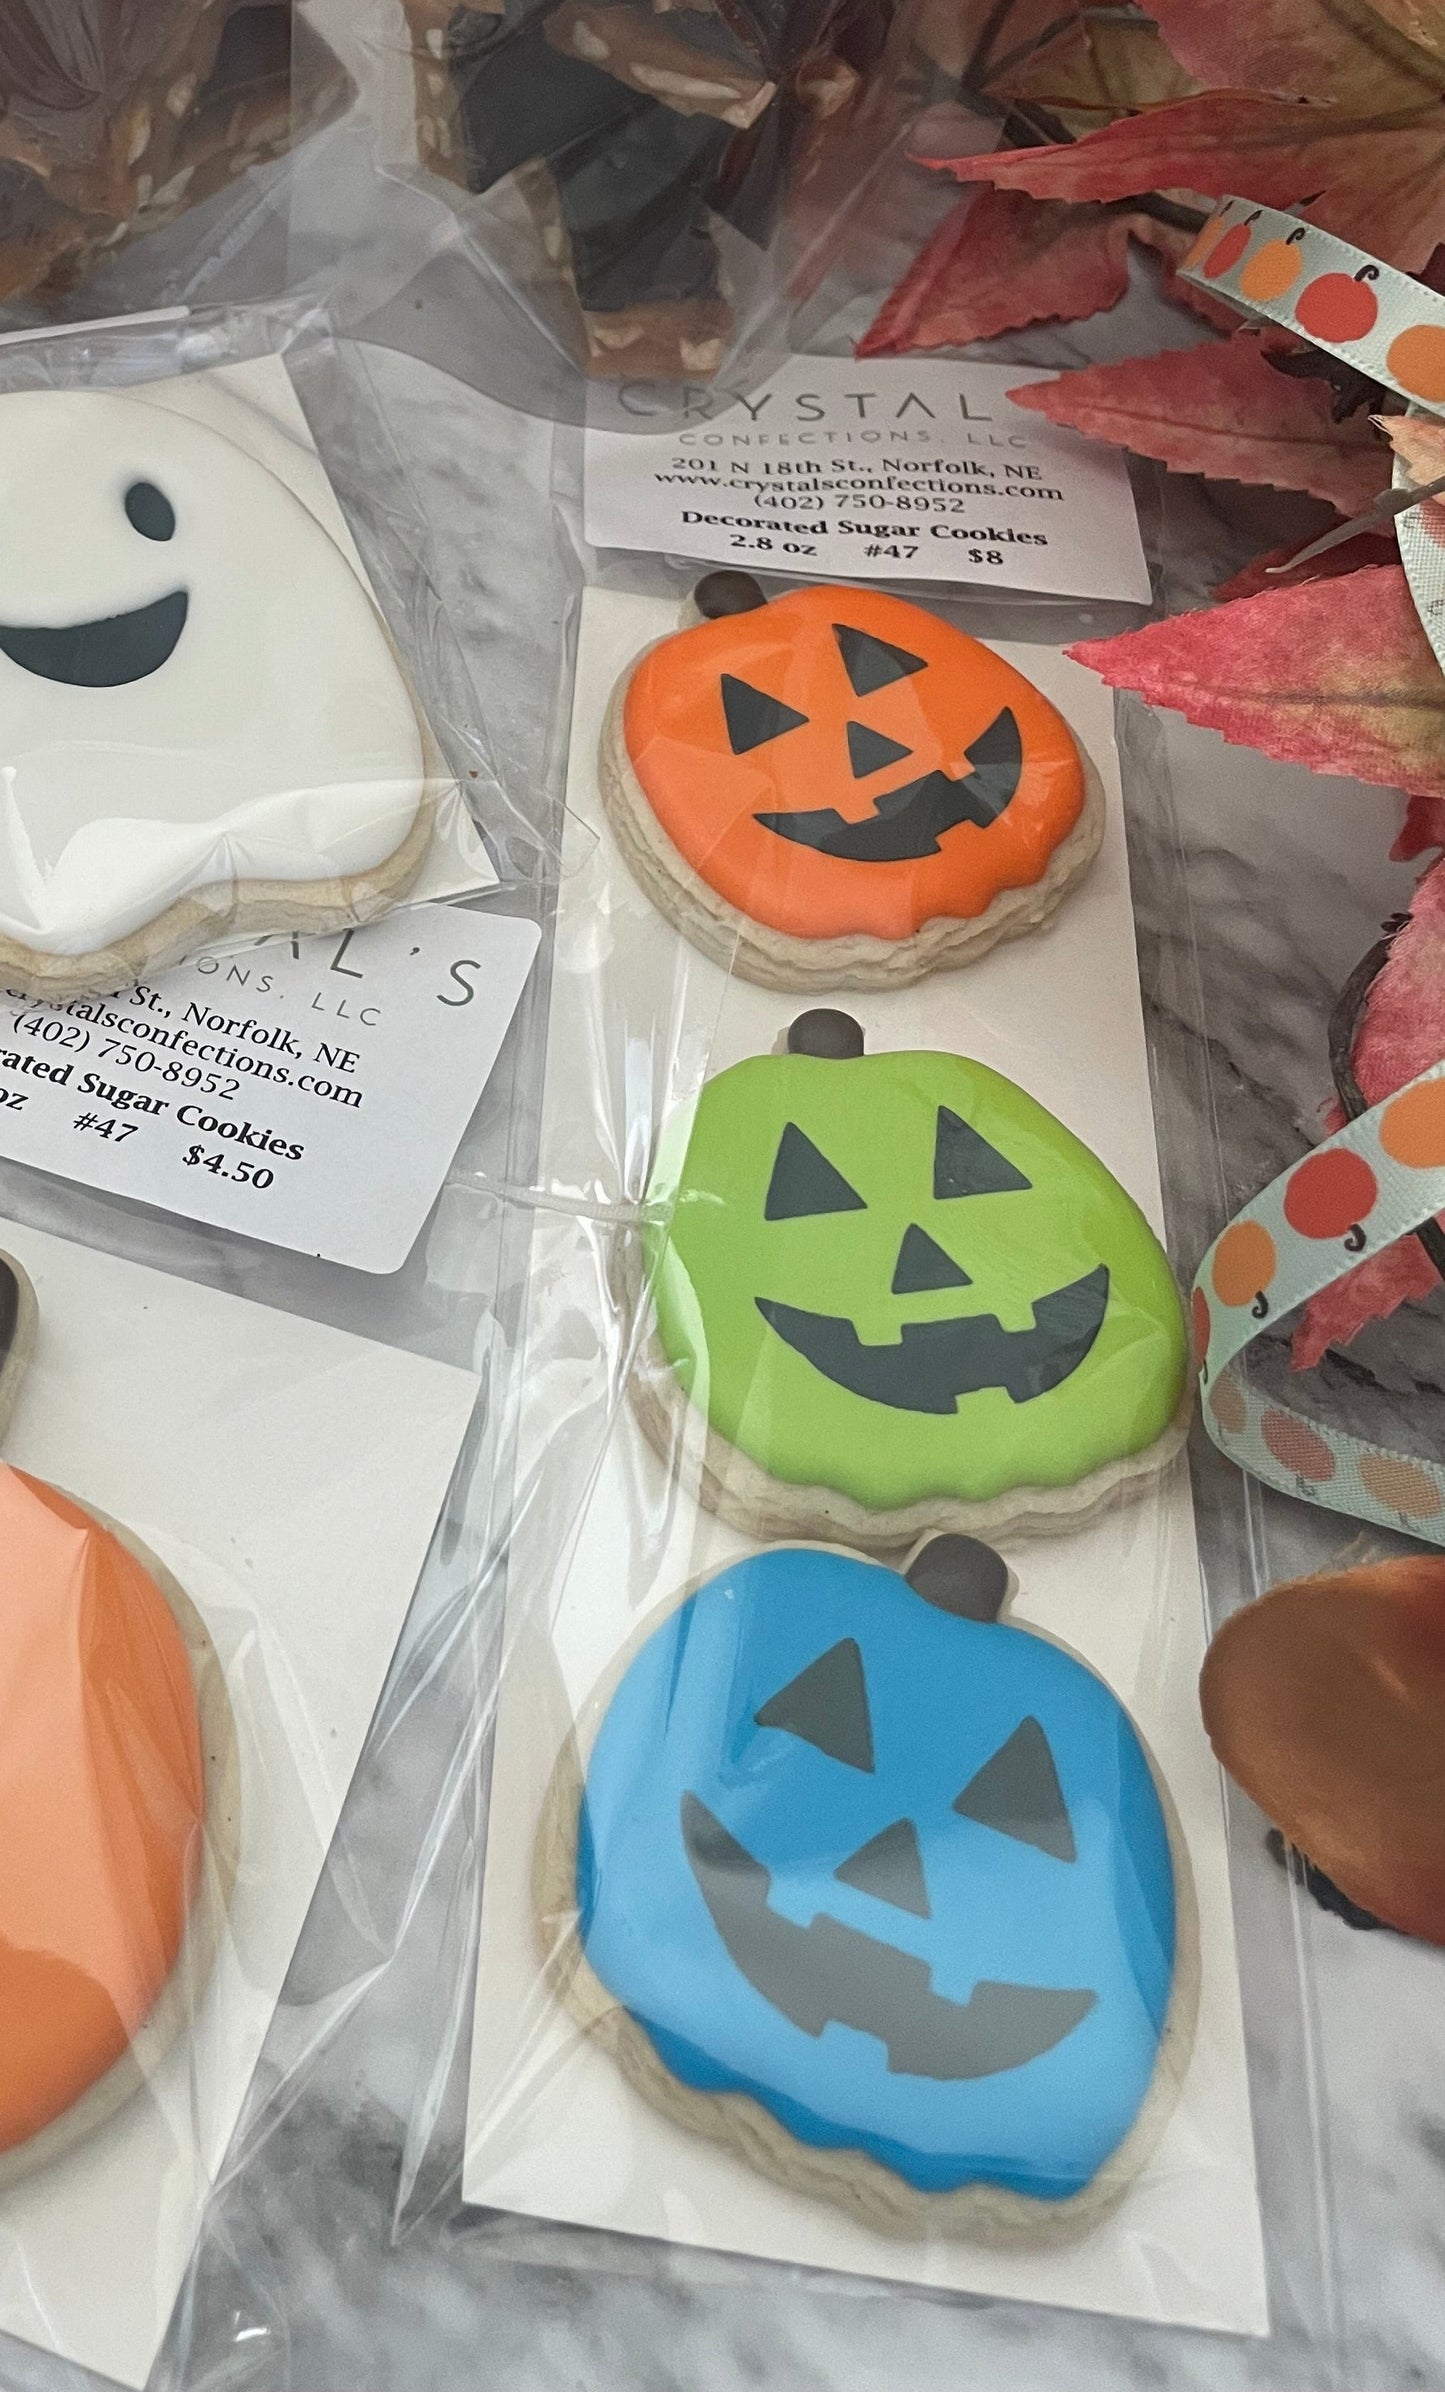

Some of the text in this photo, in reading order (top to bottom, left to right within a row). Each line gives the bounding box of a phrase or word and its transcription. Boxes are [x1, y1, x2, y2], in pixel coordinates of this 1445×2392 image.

[618, 380, 993, 422] CRYSTAL
[967, 433, 1027, 449] LLC
[655, 473, 1064, 501] www.crystalsconfections.com
[672, 457, 718, 472] 201
[731, 461, 749, 474] N
[764, 460, 822, 475] 18th
[883, 458, 995, 478] Norfolk,
[1004, 464, 1043, 481] NE
[754, 494, 965, 513] (402) 750-8952
[681, 510, 1048, 546] Decorated Sugar Cookies
[730, 534, 1004, 566] 2.8 oz #47 $8
[311, 991, 381, 1027] LLC
[181, 1001, 302, 1059] Norfolk,
[313, 1042, 360, 1073] NE
[13, 1014, 241, 1100] (402) 750-8952
[77, 1072, 169, 1116] Sugar
[176, 1104, 304, 1160] Cookies
[73, 1112, 138, 1142] #47
[182, 1145, 274, 1189] $4.50
